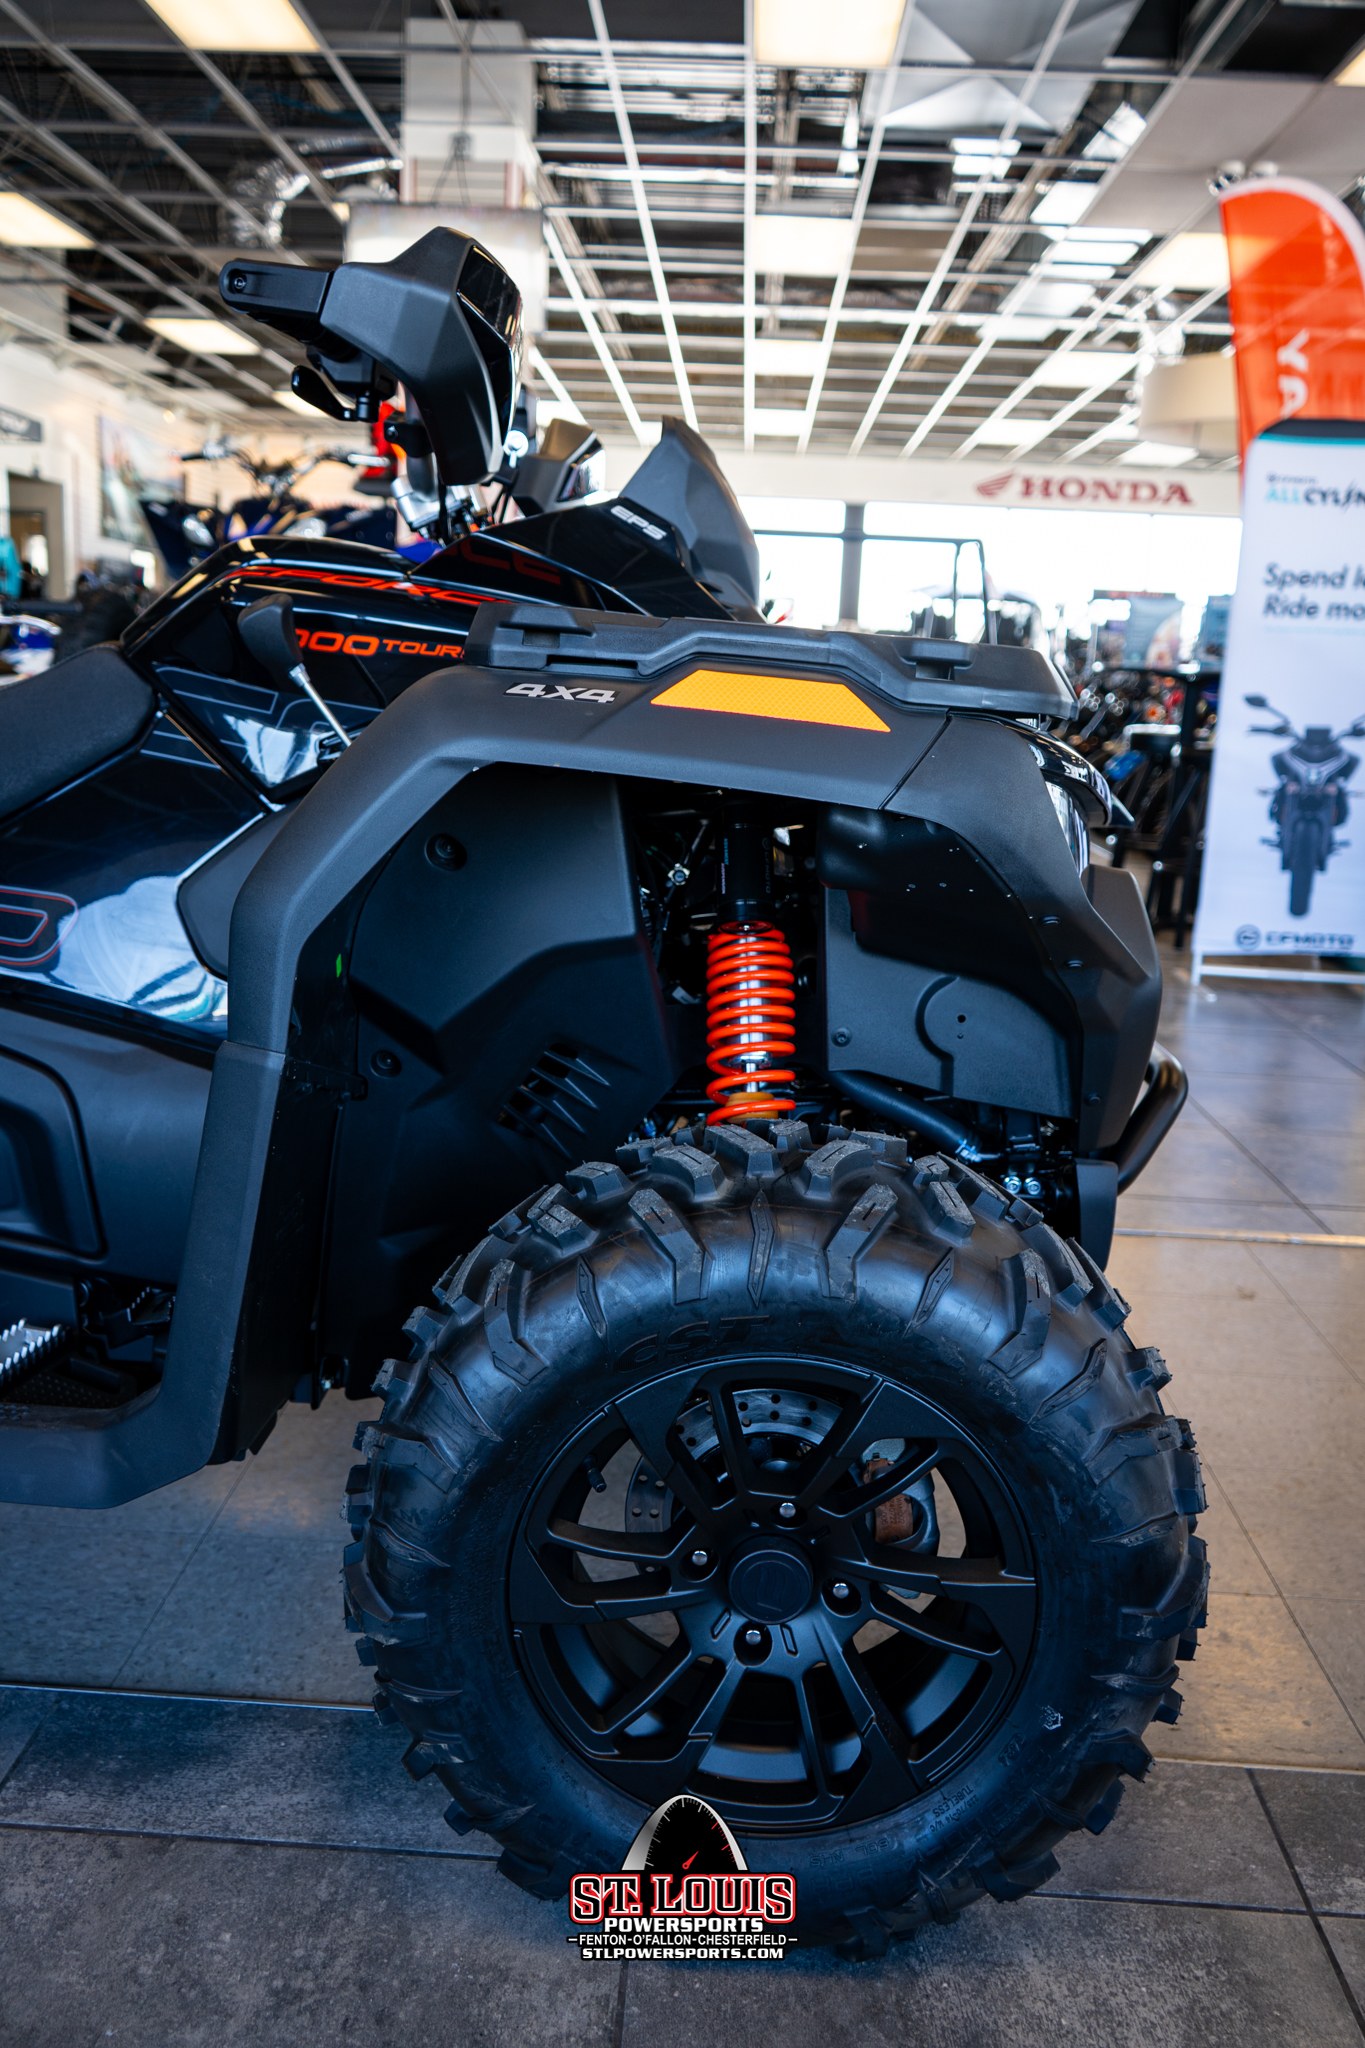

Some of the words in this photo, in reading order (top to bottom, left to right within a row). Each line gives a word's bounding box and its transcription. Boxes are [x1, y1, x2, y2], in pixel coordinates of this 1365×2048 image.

[1020, 475, 1196, 507] HONDA
[609, 504, 668, 541] EPS
[224, 565, 514, 606] CFORC
[1263, 562, 1349, 593] Spend
[1263, 593, 1319, 619] Ride
[382, 638, 466, 659] TOUR
[505, 682, 616, 704] 4X4
[612, 1314, 771, 1374] CST
[931, 1784, 975, 1818] TUBELESS
